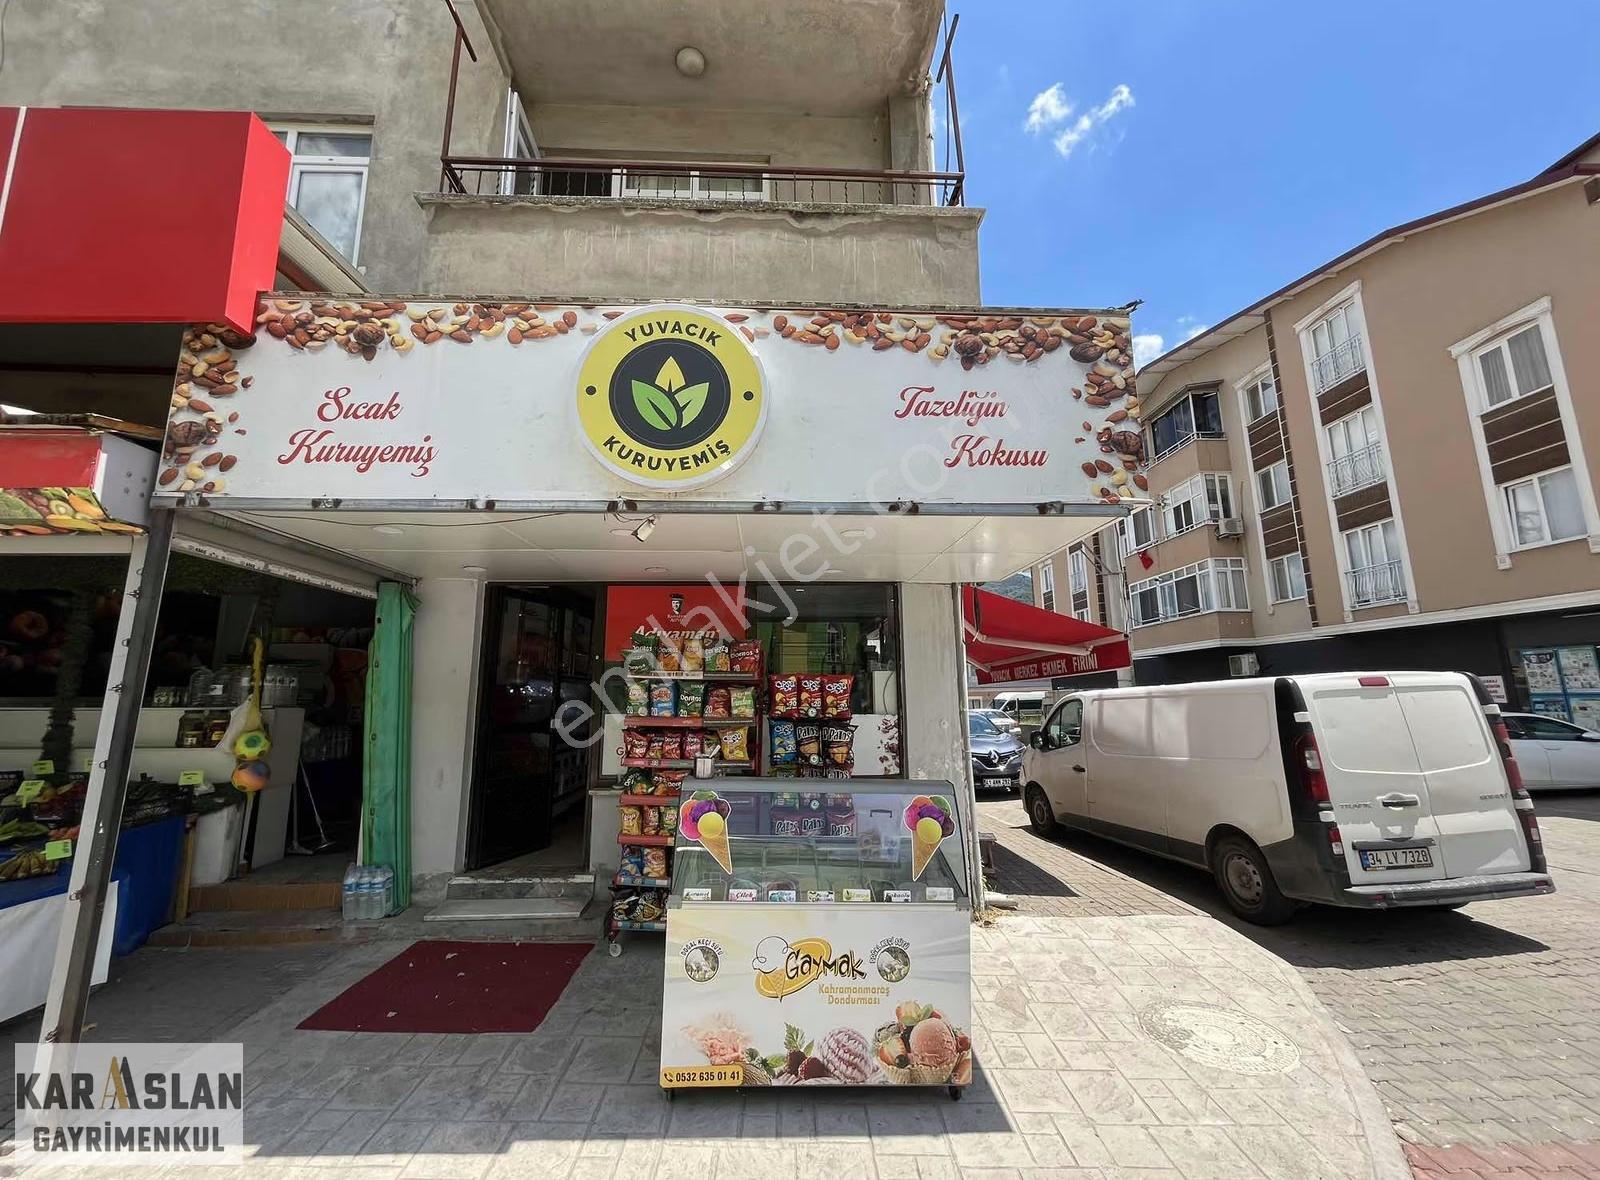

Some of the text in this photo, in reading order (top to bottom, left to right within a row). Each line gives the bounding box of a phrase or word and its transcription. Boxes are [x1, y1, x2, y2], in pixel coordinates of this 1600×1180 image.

[624, 320, 723, 348] YUVACIK
[316, 386, 404, 423] Sıcak
[894, 386, 1008, 427] Tazeliğin
[277, 427, 438, 477] Kuruyemiş
[602, 434, 733, 472] KURUYEMİŞ
[943, 434, 1050, 468] Kokusu
[1041, 659, 1068, 676] EKMEK
[1072, 653, 1098, 672] FIRINI
[1369, 853, 1382, 866] 34
[1402, 850, 1429, 864] 7328
[785, 949, 867, 981] Gaymak
[819, 984, 890, 996] Kahramanmaraş
[828, 995, 880, 1005] Dondurması
[676, 1071, 740, 1082] 0532 635 01 41
